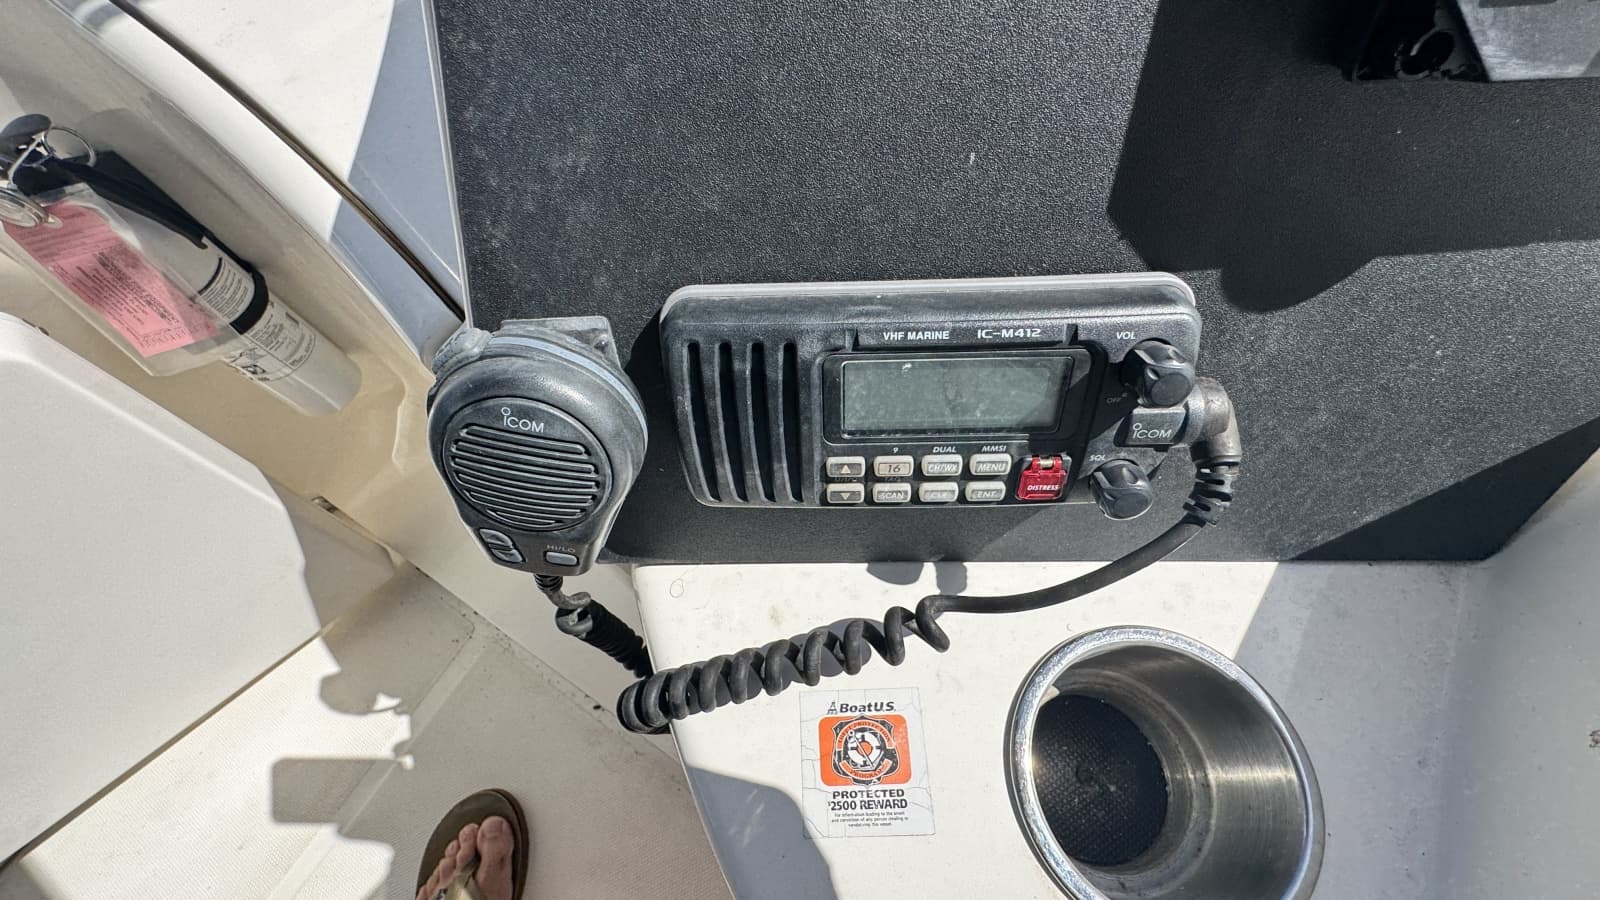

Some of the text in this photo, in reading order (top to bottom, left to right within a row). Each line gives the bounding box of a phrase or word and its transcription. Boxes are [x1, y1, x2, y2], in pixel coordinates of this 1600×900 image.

[883, 331, 949, 340] VHF MARINE
[977, 328, 1042, 339] IC-M412
[1116, 331, 1136, 340] VOL
[888, 464, 901, 473] 16
[977, 463, 1006, 473] MENU
[879, 491, 905, 499] SCAN
[833, 789, 905, 799] PROTECTED
[860, 799, 908, 810] REWARD
